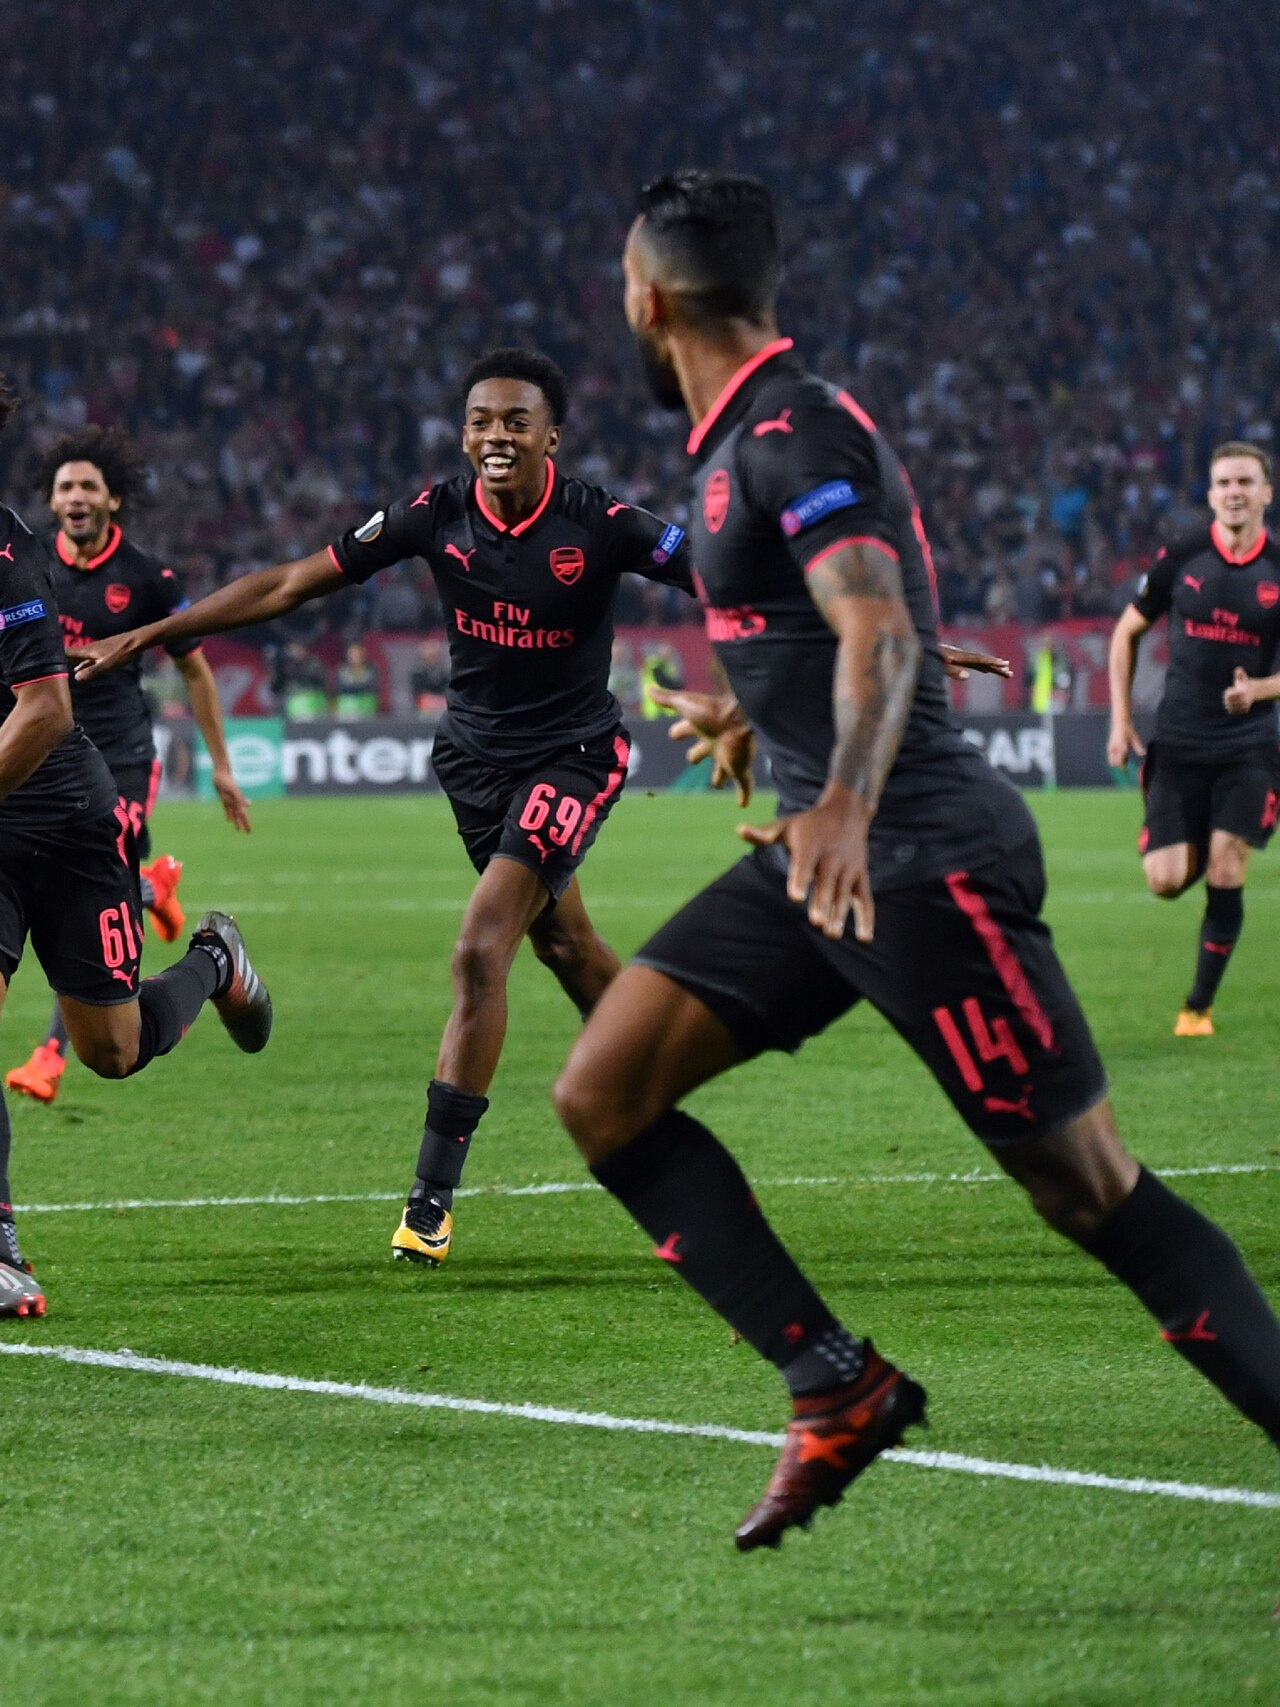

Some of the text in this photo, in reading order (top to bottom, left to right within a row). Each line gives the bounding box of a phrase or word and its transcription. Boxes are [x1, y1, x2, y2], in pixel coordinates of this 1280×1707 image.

[4, 603, 44, 623] RESPECT
[454, 607, 575, 648] Emirates
[493, 601, 530, 626] Fly
[198, 730, 441, 788] enter
[519, 783, 582, 847] 69
[99, 901, 137, 968] 61
[932, 997, 1030, 1092] 14
